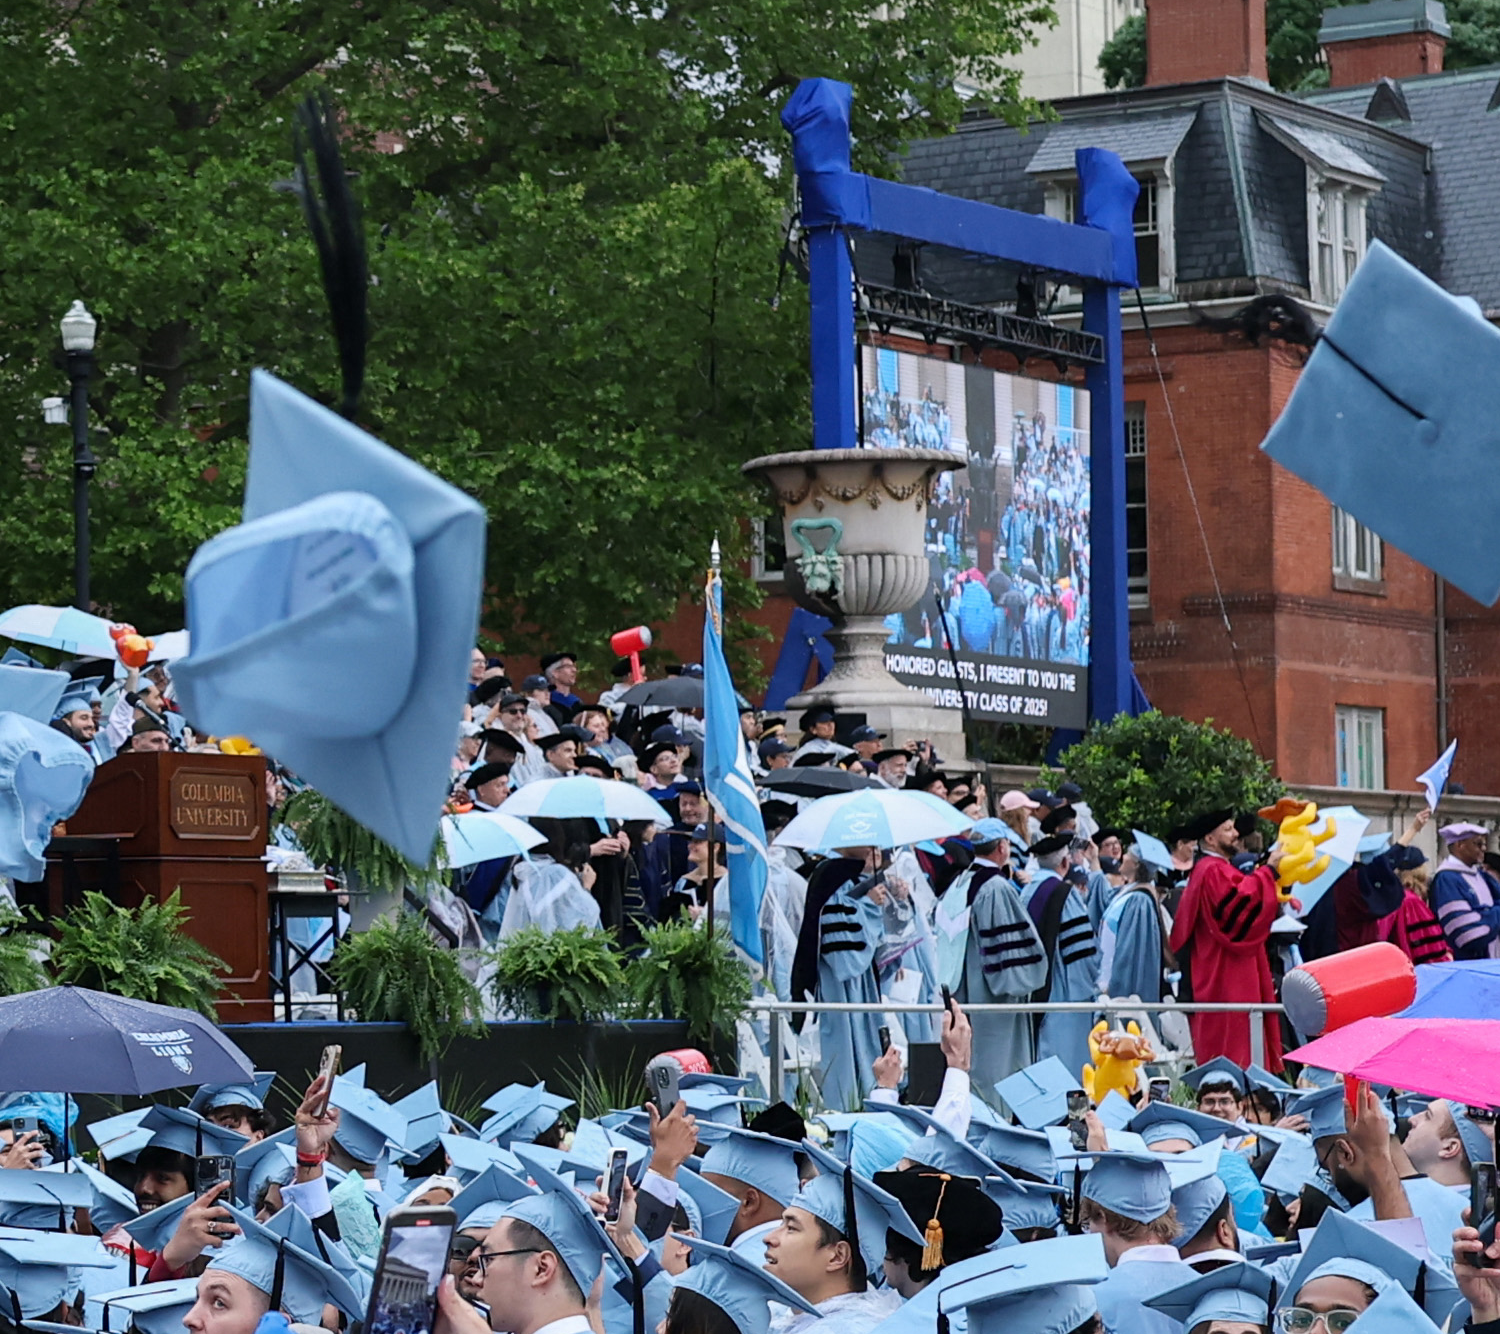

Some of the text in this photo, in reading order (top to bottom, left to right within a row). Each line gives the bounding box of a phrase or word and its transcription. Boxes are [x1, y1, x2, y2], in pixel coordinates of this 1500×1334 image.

[886, 654, 936, 677] HONORED
[979, 663, 985, 682] I
[986, 665, 1026, 686] PRESENT
[1027, 670, 1039, 688] TO
[1039, 671, 1058, 690] YOU
[1059, 673, 1076, 692] THE
[921, 687, 1048, 717] NIVERSTY CLASS OF 2025!
[181, 783, 245, 804] COLUMBIA
[176, 807, 248, 827] UNIVERSITY
